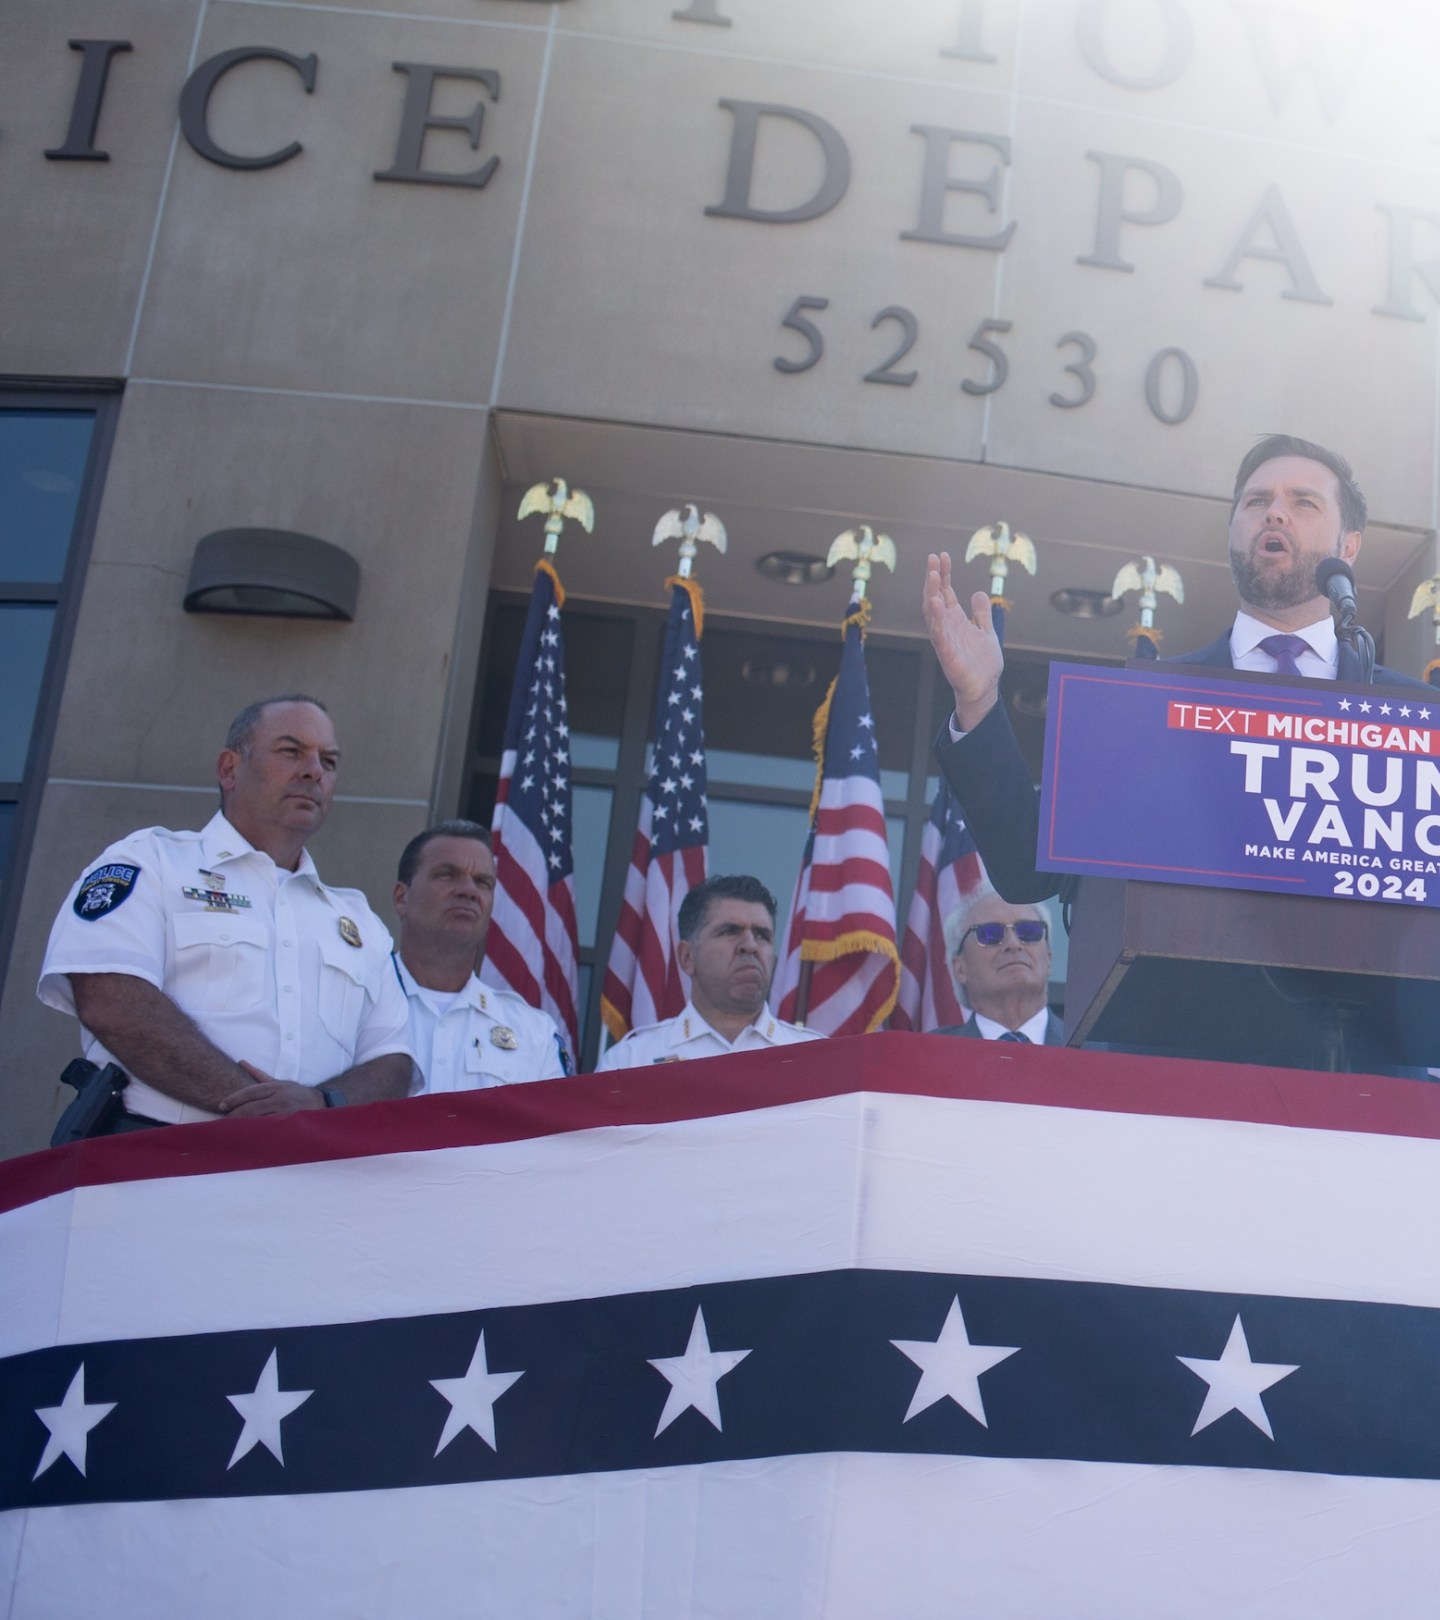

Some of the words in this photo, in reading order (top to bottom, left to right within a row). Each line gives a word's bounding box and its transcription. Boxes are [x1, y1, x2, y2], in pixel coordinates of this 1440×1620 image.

[773, 295, 1200, 426] 52530
[1174, 703, 1257, 734] TEXT
[1267, 713, 1431, 753] MICHIGAN
[1245, 844, 1296, 861] MAKE
[1302, 850, 1384, 869] AMERICA
[1333, 871, 1427, 902] 2024
